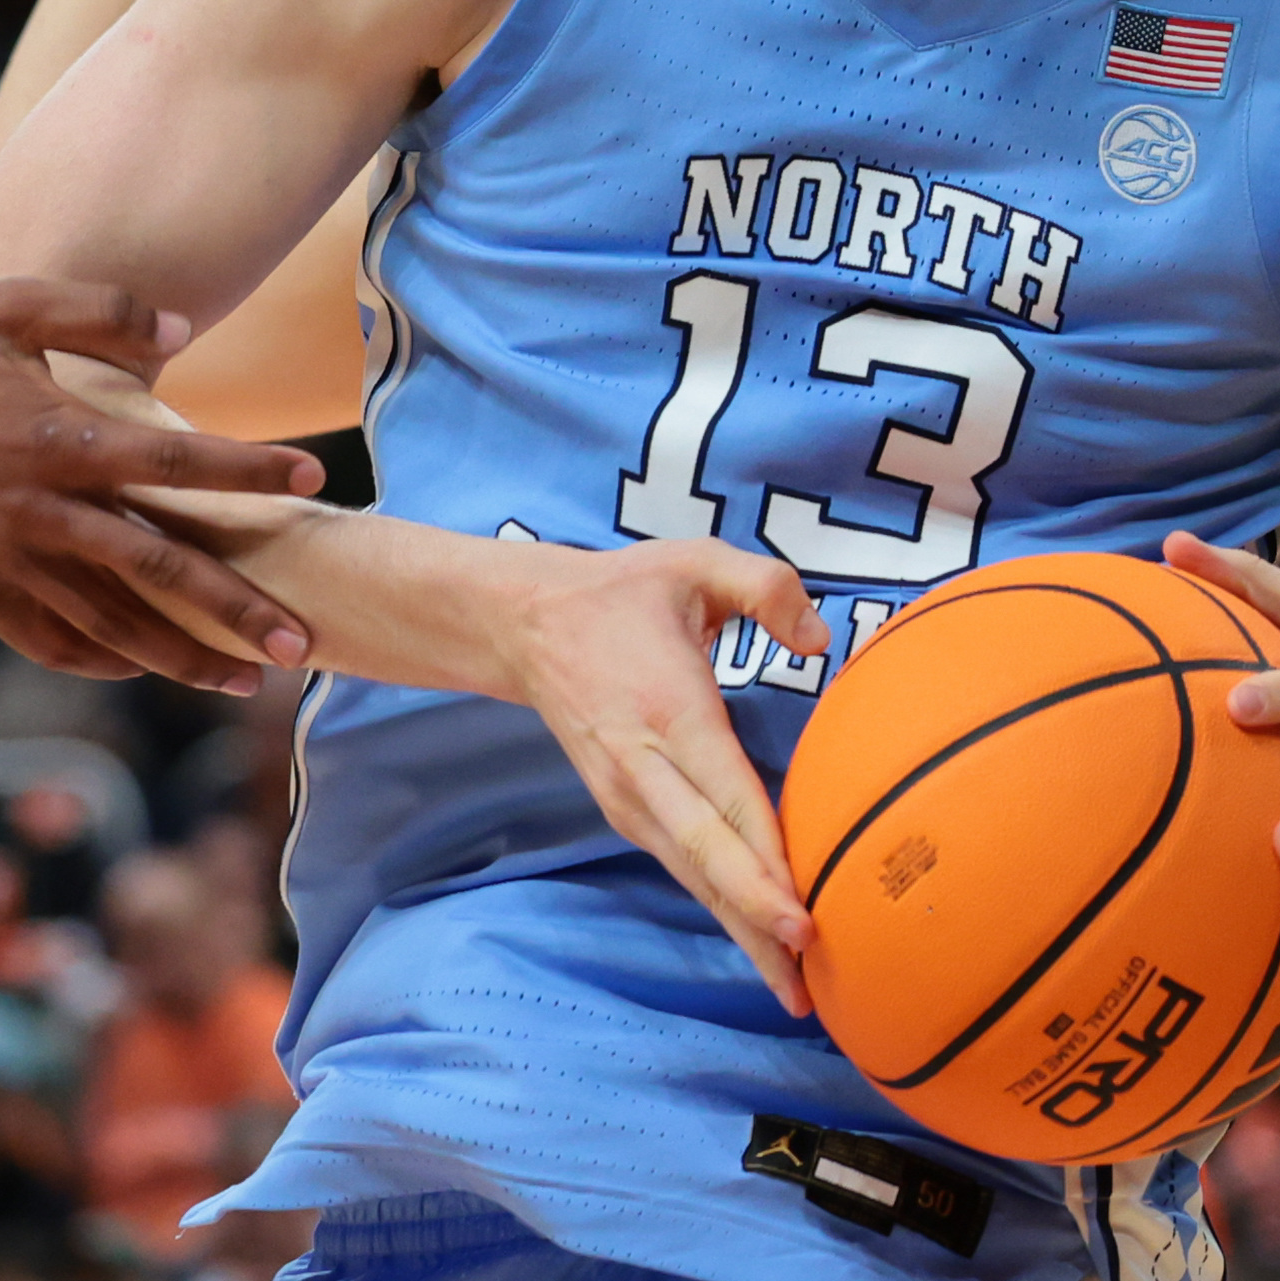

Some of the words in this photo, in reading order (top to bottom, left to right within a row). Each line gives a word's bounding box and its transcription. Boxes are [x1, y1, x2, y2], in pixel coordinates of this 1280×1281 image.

[1116, 137, 1190, 166] ACC
[668, 154, 1082, 334] NORTH
[614, 267, 1035, 587] 13
[1082, 955, 1147, 1032] OFFICIAL
[1003, 1060, 1051, 1099] BALL
[1039, 974, 1205, 1128] PRO
[1042, 1026, 1091, 1076] GAME
[916, 1180, 956, 1218] 50
